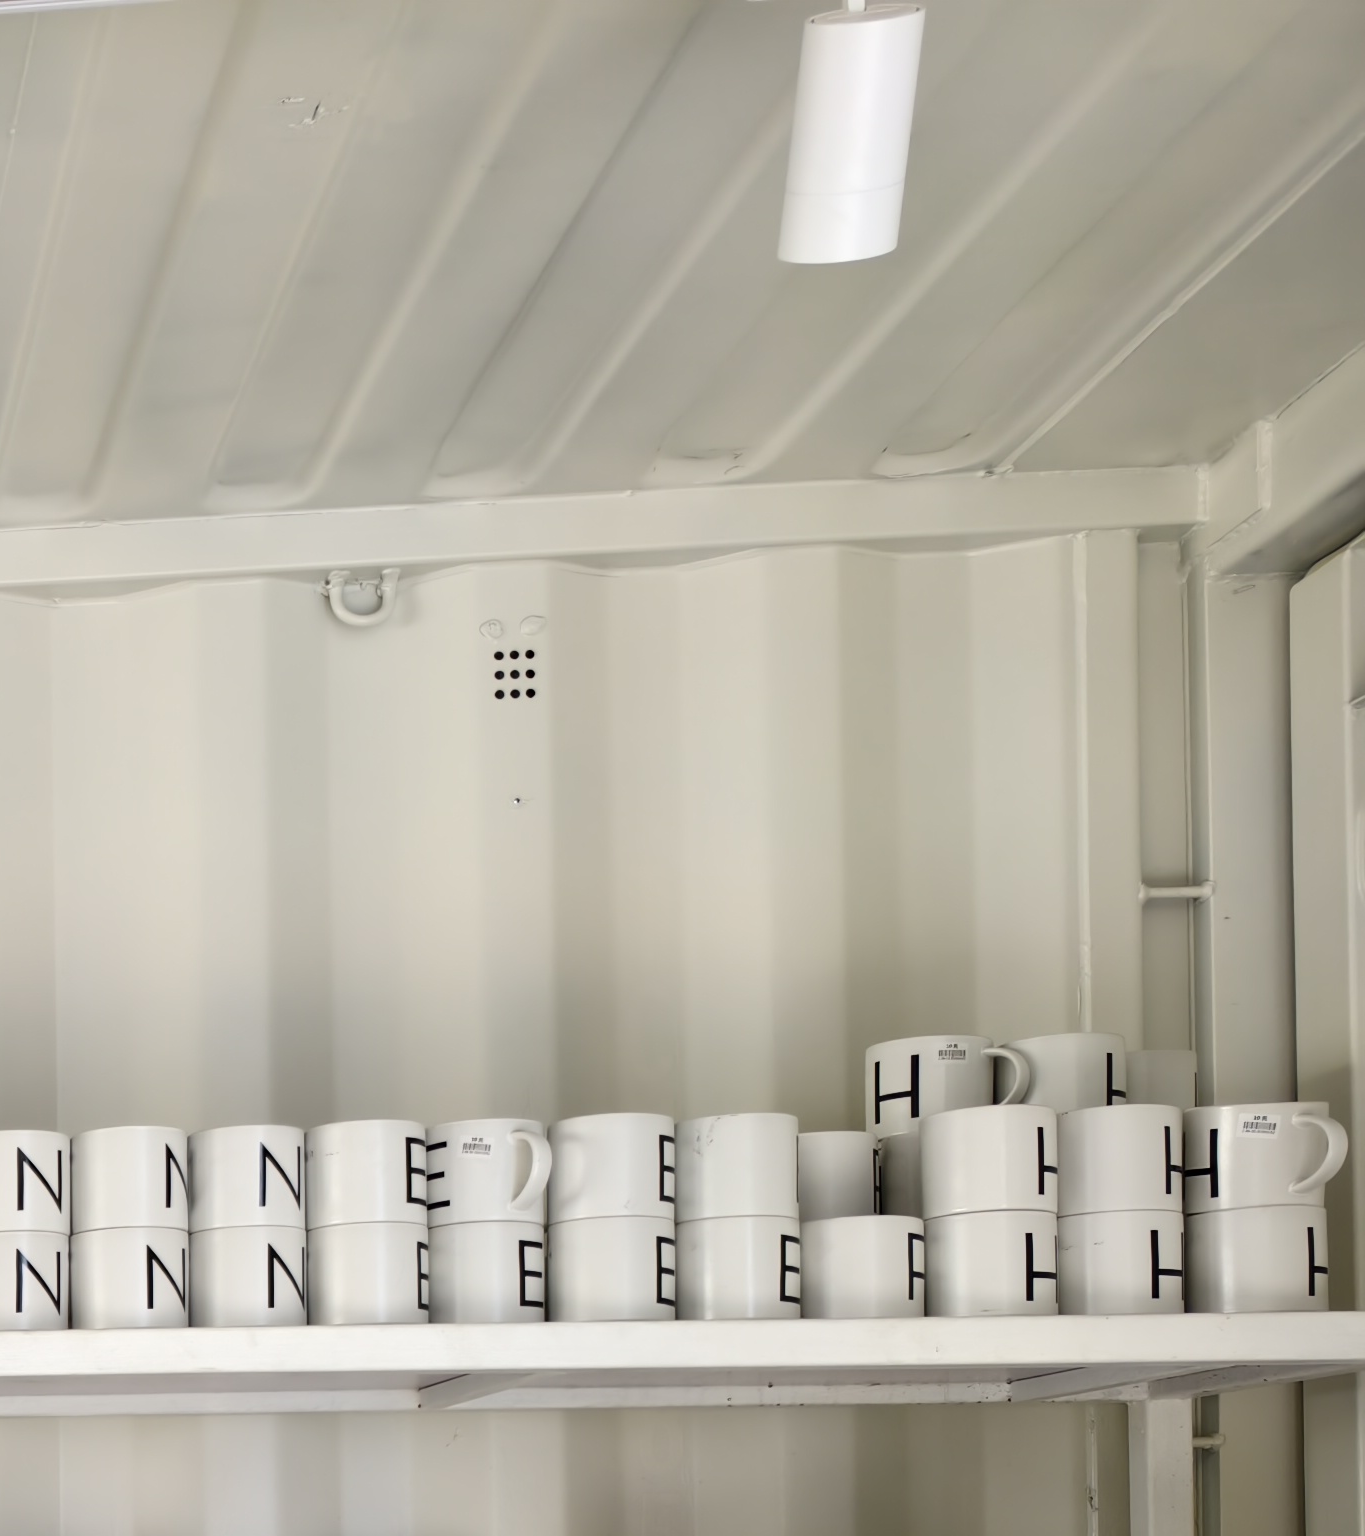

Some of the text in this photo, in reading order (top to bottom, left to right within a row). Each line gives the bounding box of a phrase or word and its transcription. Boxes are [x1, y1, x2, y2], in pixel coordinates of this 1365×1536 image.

[874, 1054, 919, 1124] H
[17, 1147, 62, 1213] N
[147, 1245, 186, 1311] N
[519, 1240, 543, 1308] E
